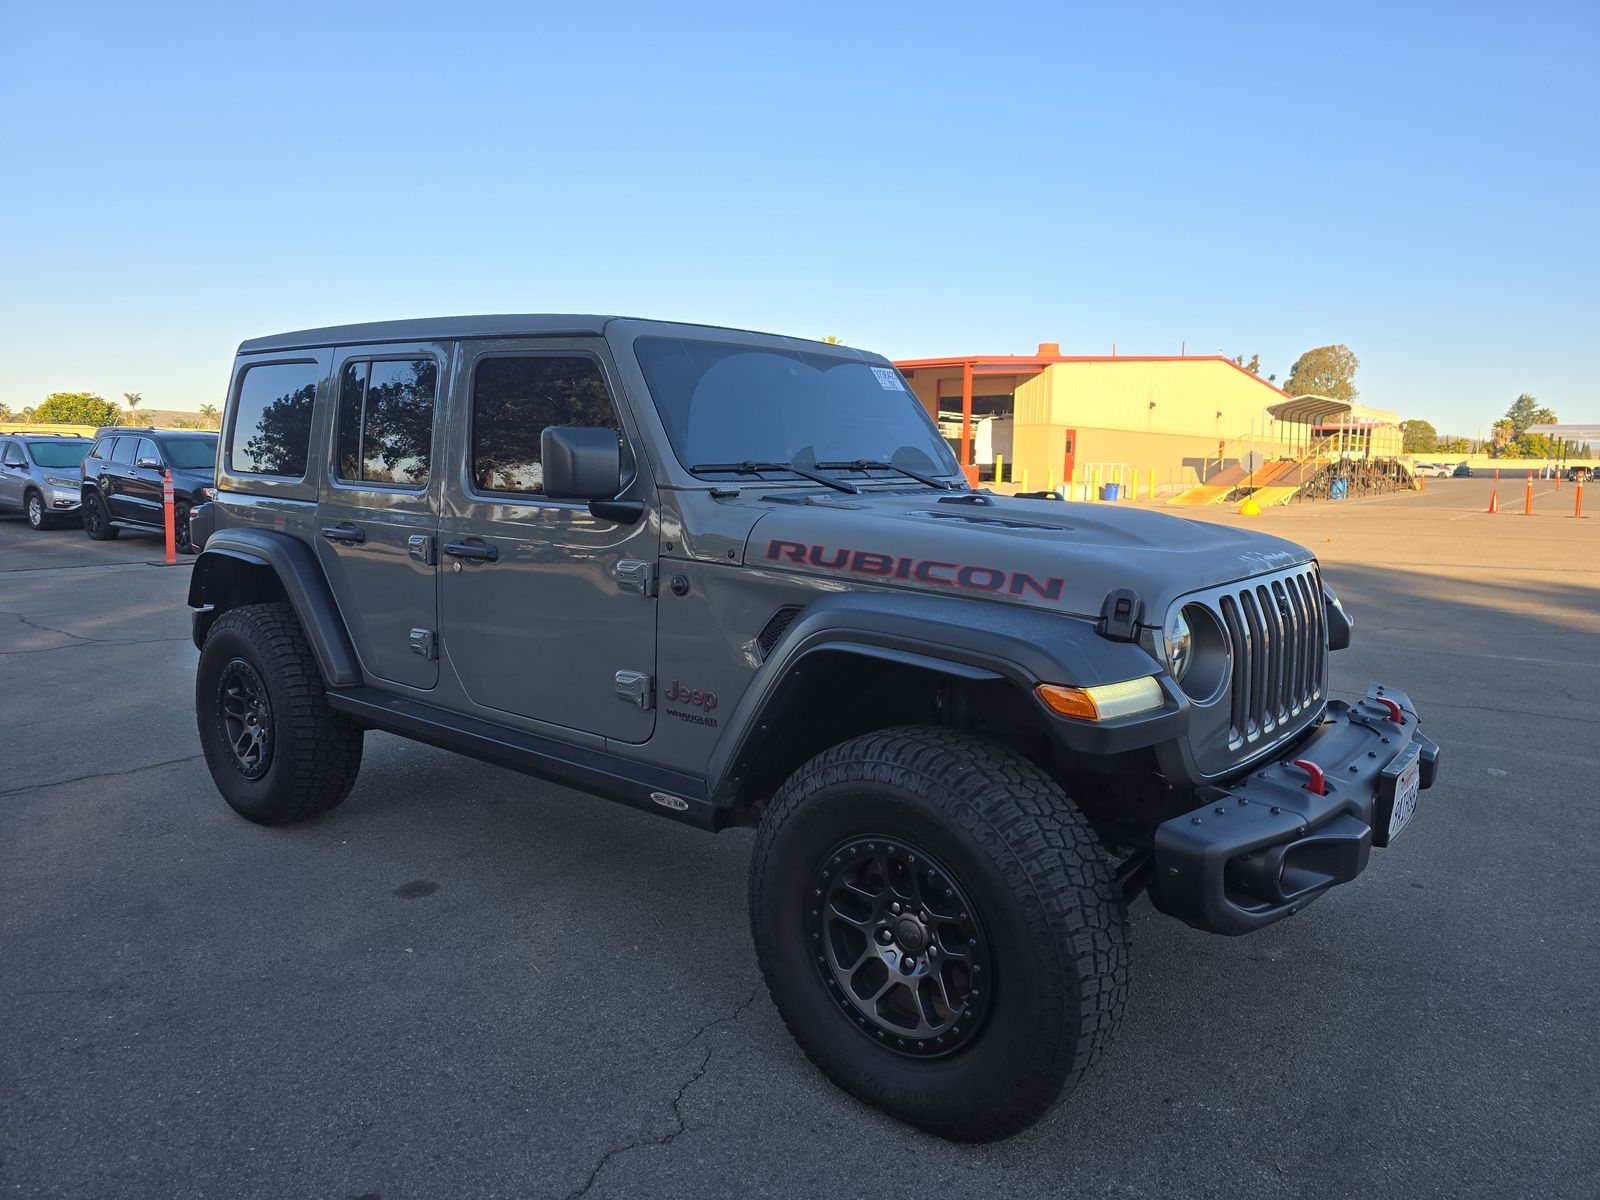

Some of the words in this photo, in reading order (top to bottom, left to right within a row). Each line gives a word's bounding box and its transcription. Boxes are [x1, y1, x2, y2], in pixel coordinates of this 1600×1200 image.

[765, 539, 1065, 601] RUBICON
[664, 679, 718, 712] Jeep
[666, 708, 718, 728] WRANGLER
